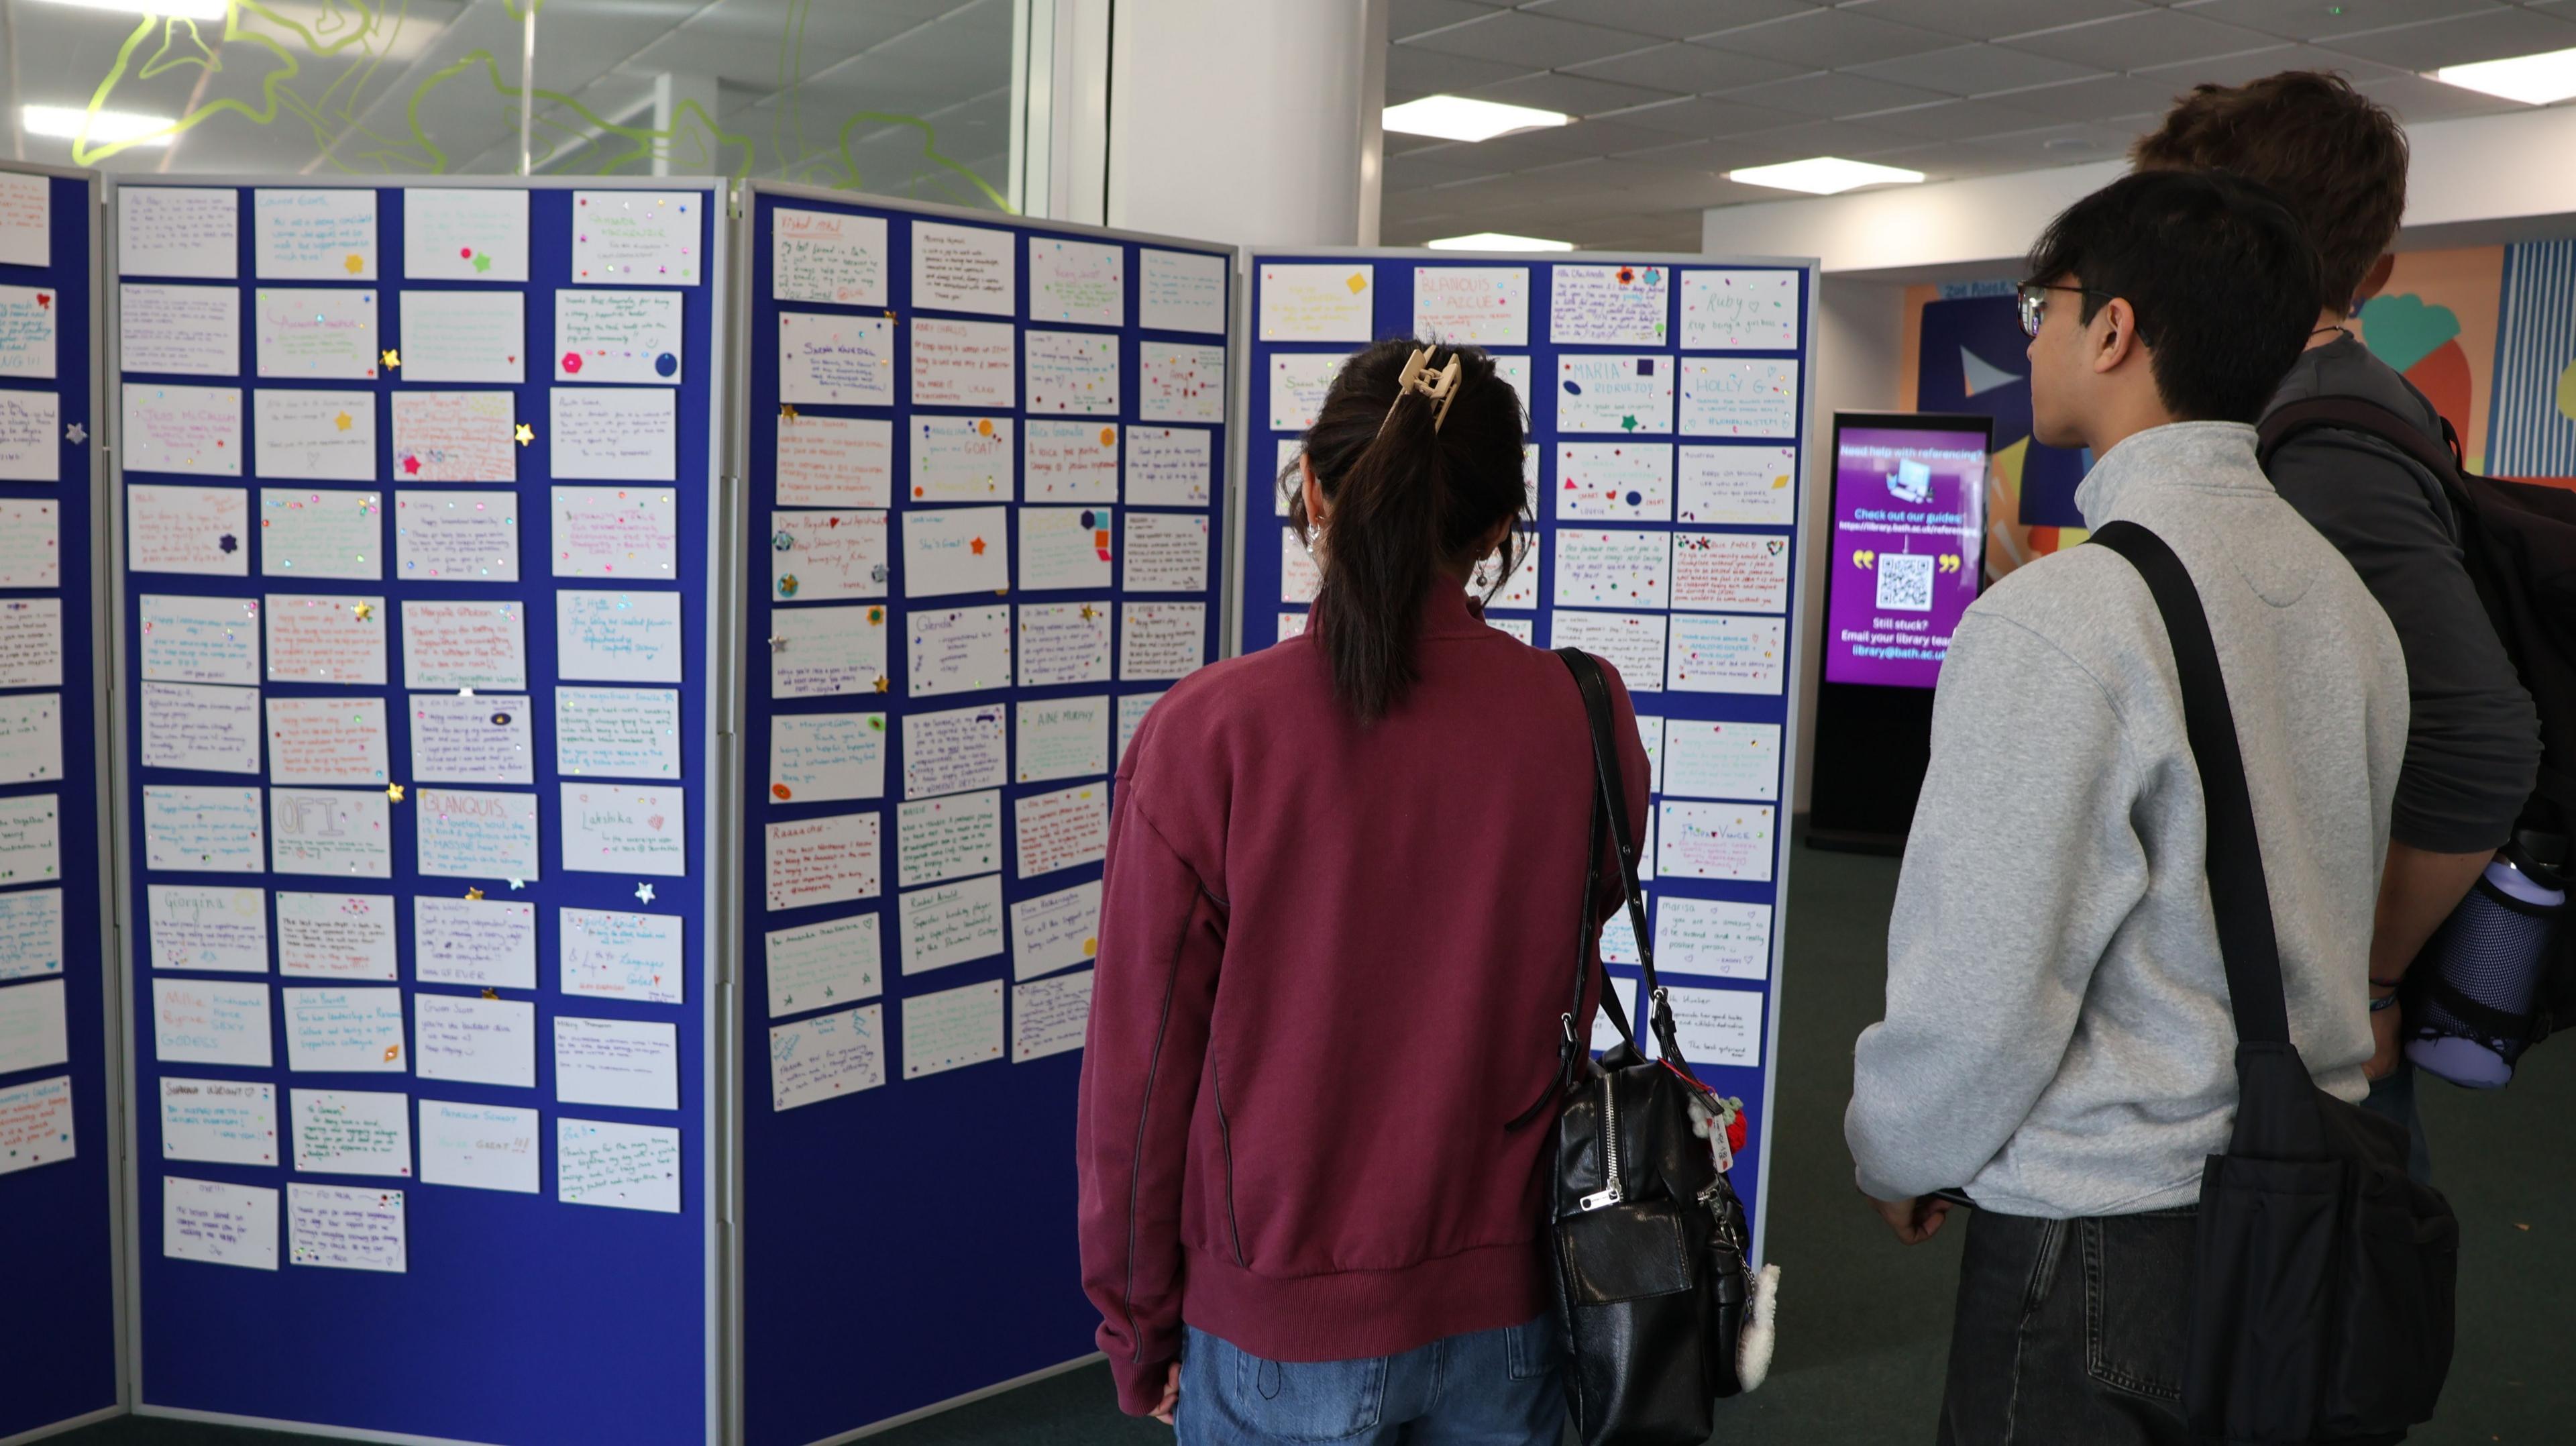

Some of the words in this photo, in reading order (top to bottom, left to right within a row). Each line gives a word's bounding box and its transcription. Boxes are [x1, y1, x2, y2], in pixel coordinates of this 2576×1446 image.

[1841, 445, 1867, 456] Need
[1870, 446, 1891, 458] help
[1894, 448, 1915, 458] with
[1918, 448, 1982, 462] referencing?
[1854, 509, 1886, 521] Check
[1887, 512, 1905, 521] out
[1907, 513, 1924, 522] our
[1873, 617, 1892, 629] Still
[1894, 619, 1928, 631] stuck?
[1841, 629, 1869, 642] Email
[1870, 633, 1894, 644] your
[1896, 633, 1931, 646] library
